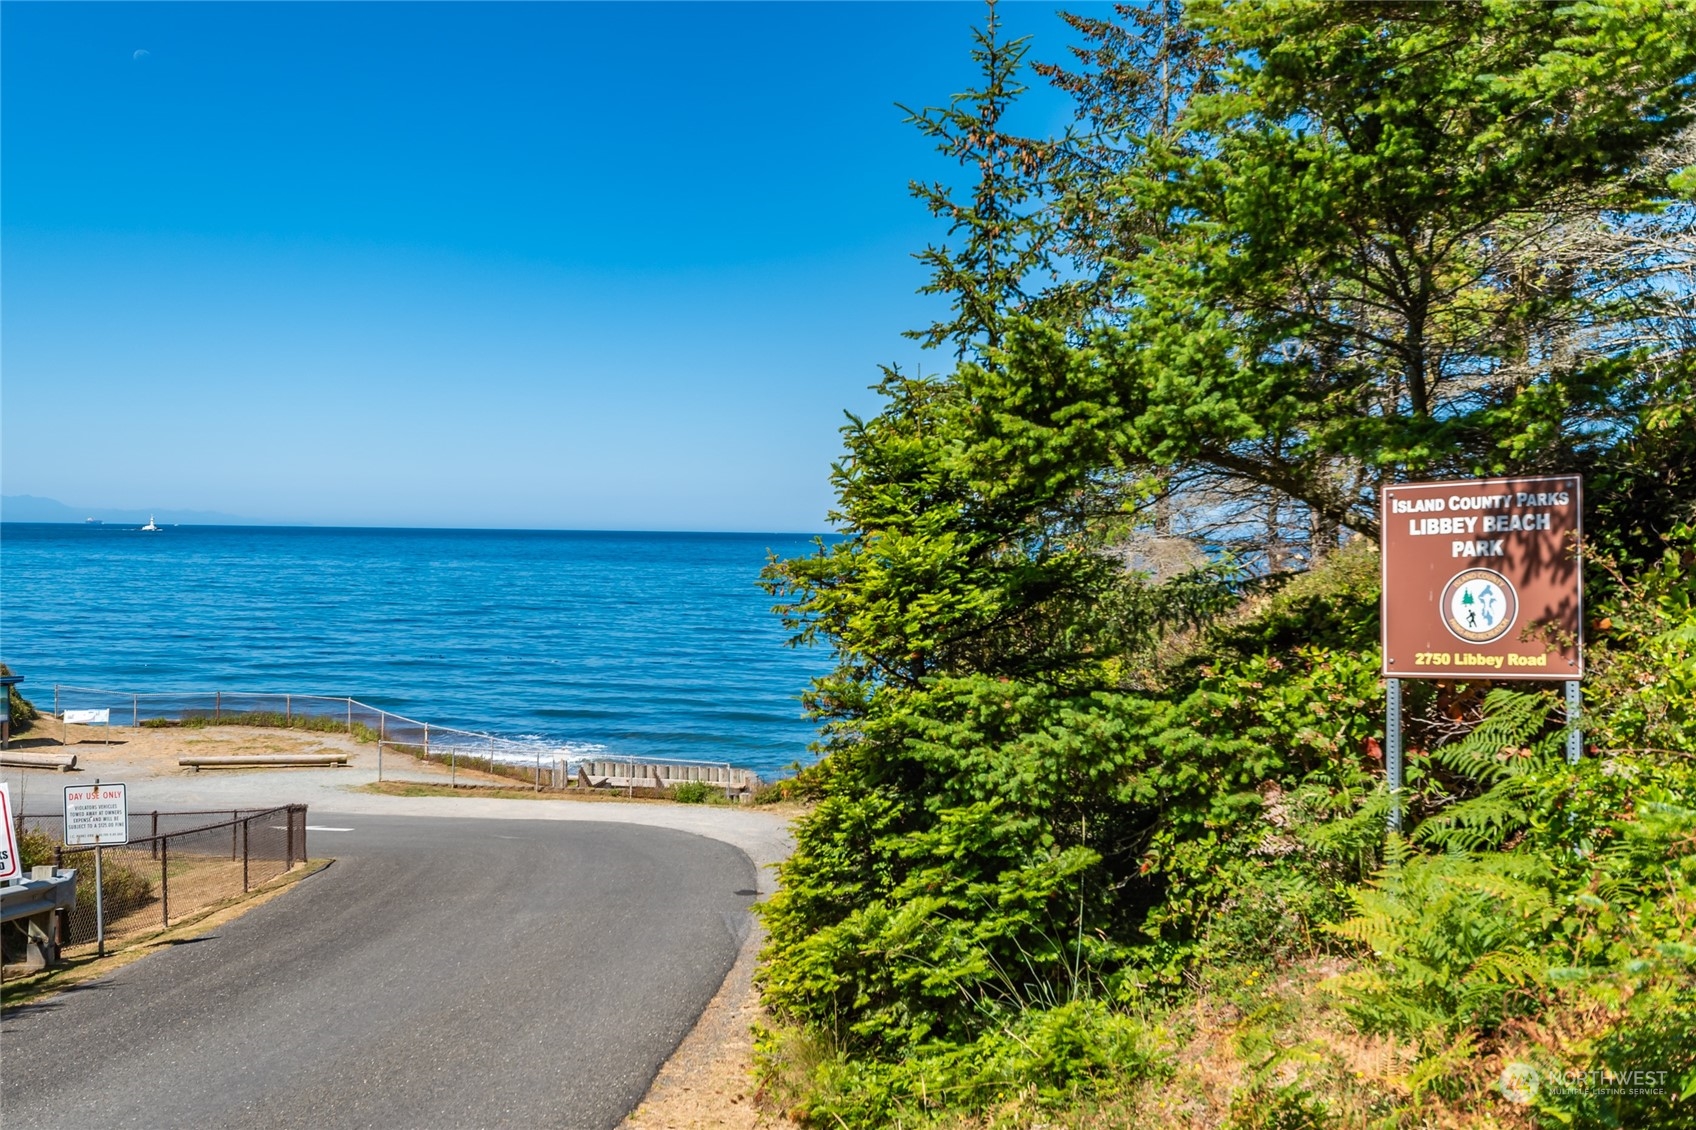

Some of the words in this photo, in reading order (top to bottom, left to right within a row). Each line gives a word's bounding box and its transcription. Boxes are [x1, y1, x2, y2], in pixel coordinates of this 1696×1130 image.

[1409, 517, 1478, 535] LIBBEY
[1483, 513, 1550, 532] BEACH
[1452, 540, 1504, 557] PARK
[1415, 653, 1451, 665] 2750
[1454, 654, 1504, 668] Libbey
[1508, 654, 1546, 666] Road
